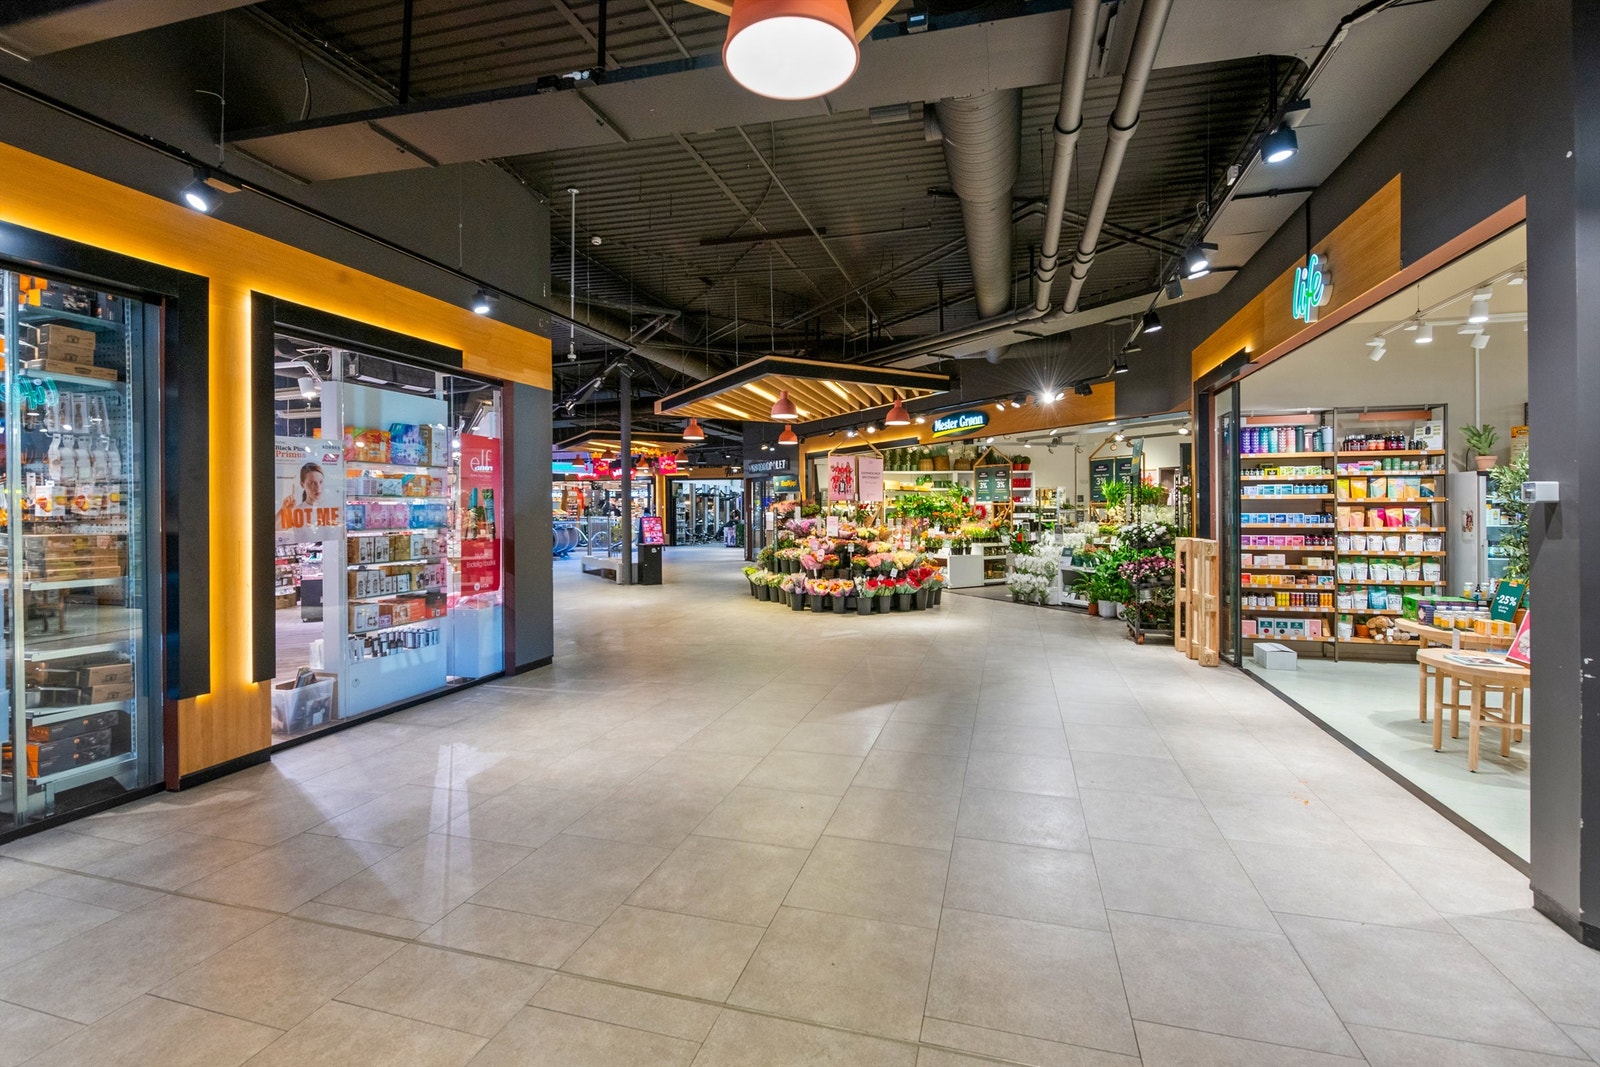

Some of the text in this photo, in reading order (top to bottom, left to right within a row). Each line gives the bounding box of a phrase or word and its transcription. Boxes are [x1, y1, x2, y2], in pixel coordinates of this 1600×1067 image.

[1293, 253, 1325, 323] life
[934, 418, 958, 431] Mester
[275, 450, 307, 459] Primus
[281, 507, 340, 529] NOT ME
[1496, 594, 1518, 607] -25%
